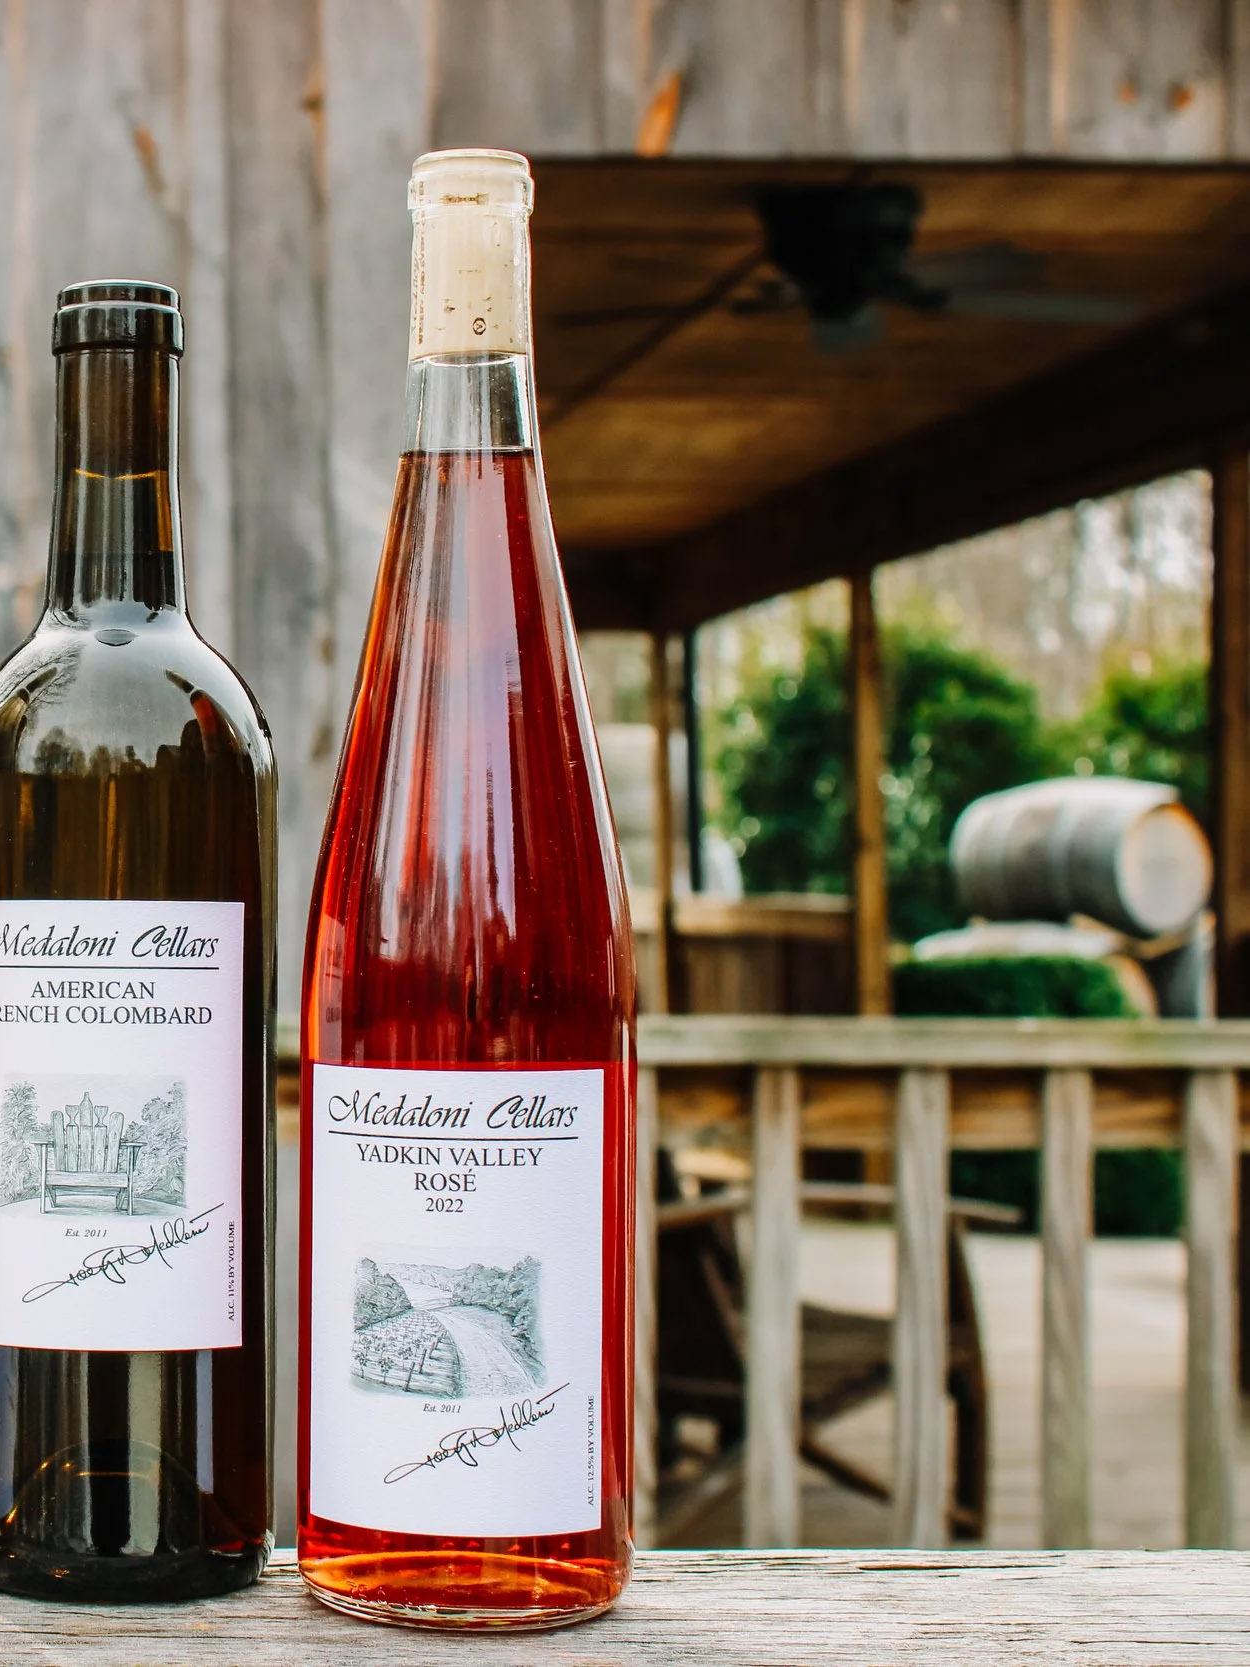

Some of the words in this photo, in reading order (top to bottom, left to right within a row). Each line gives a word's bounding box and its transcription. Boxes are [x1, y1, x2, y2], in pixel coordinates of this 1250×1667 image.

[131, 924, 220, 959] Cellars
[30, 980, 156, 1000] AMERICAN
[65, 1005, 213, 1025] COLOMBARD
[328, 1089, 474, 1129] Medaloni
[486, 1094, 579, 1130] Cellars
[356, 1142, 442, 1166] YADKIN
[448, 1146, 544, 1168] VALLEY
[414, 1168, 477, 1193] ROSÉ
[425, 1197, 464, 1213] 2022
[83, 1228, 108, 1238] 2011
[228, 1264, 235, 1278] BY
[440, 1403, 462, 1415] 2011
[587, 1395, 595, 1438] VOLUME
[587, 1440, 594, 1454] BY
